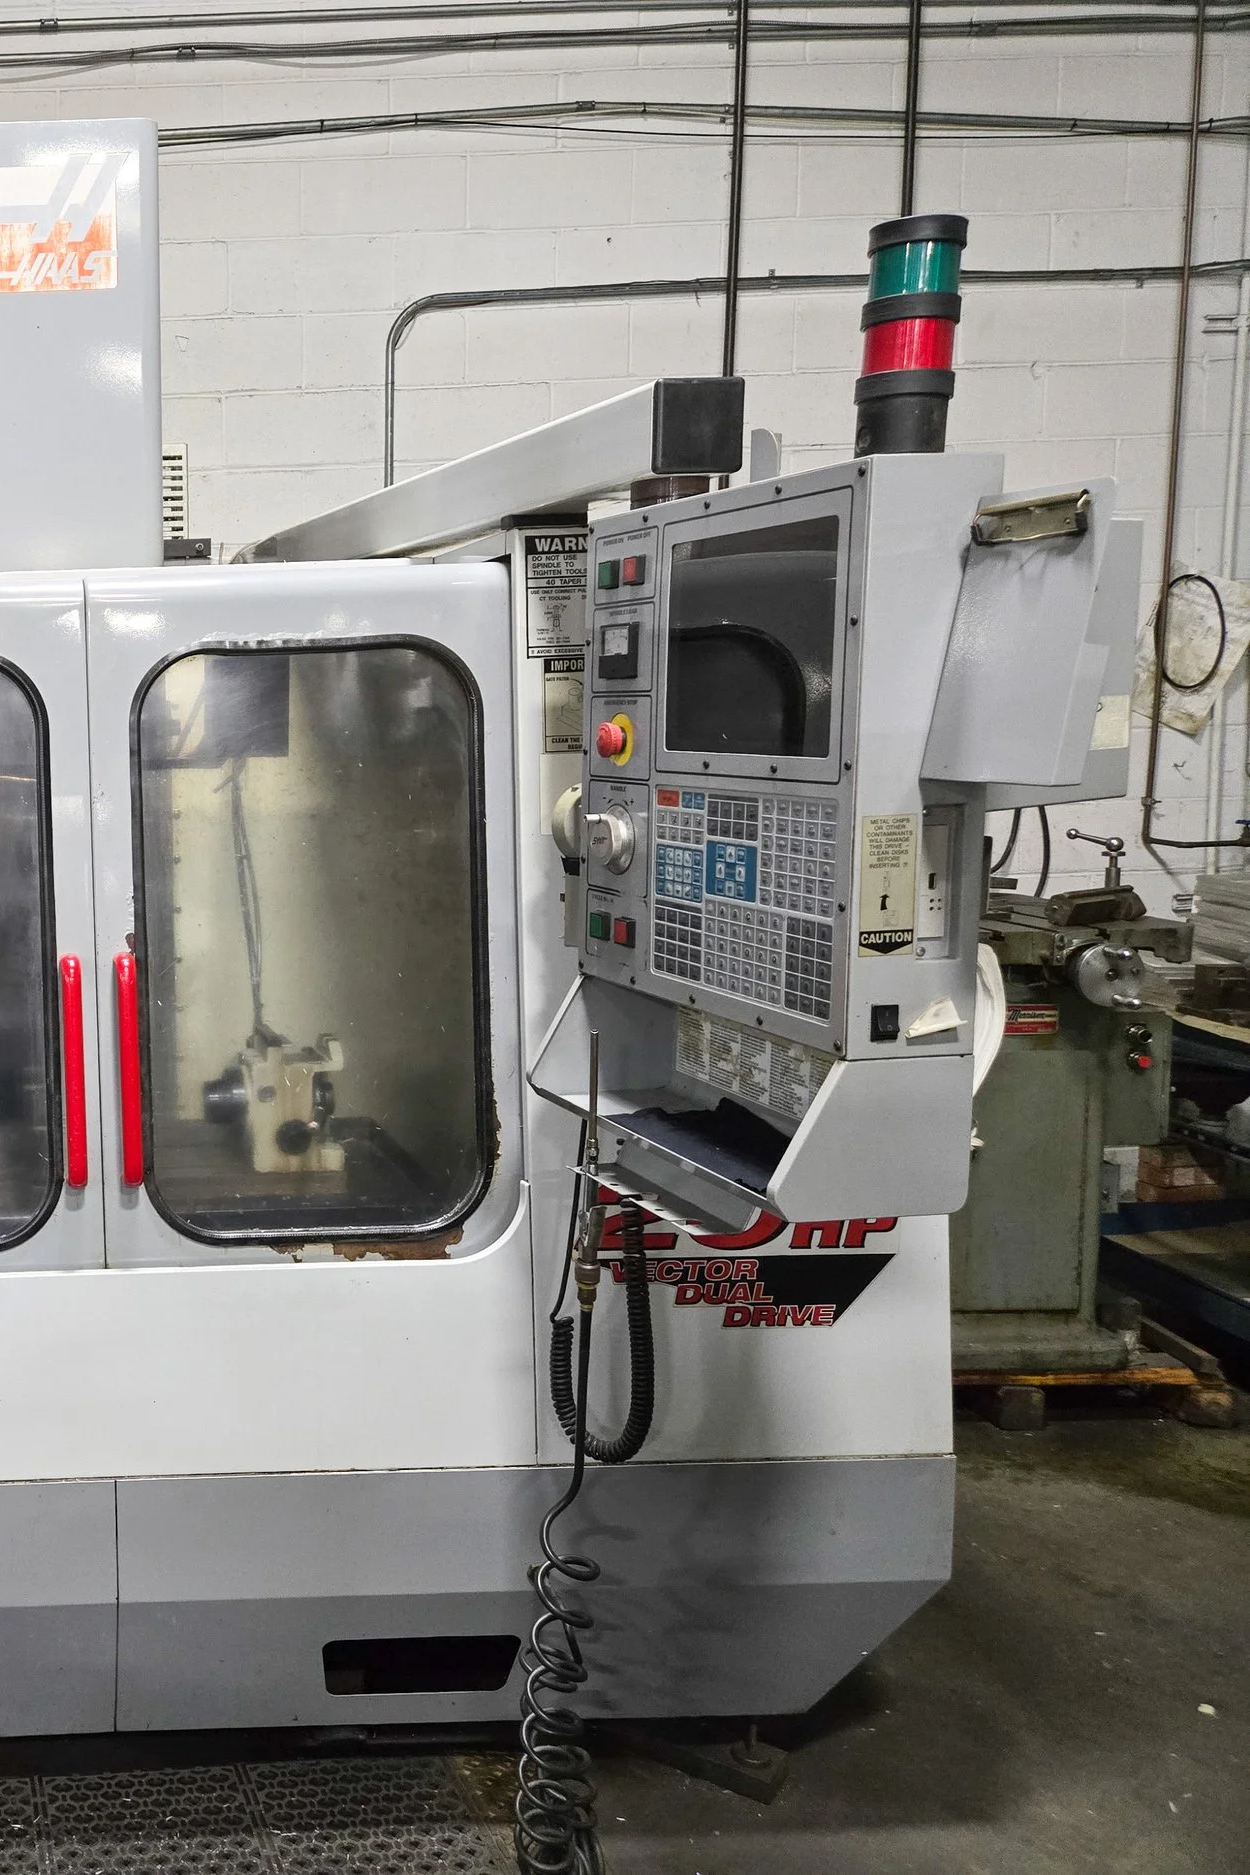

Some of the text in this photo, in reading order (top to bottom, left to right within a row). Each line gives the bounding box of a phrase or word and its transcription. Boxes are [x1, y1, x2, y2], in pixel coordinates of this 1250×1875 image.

[551, 660, 584, 671] IMPOR
[861, 932, 911, 944] CAUTION
[674, 1282, 773, 1305] DUAL
[723, 1305, 836, 1328] DRIVE
